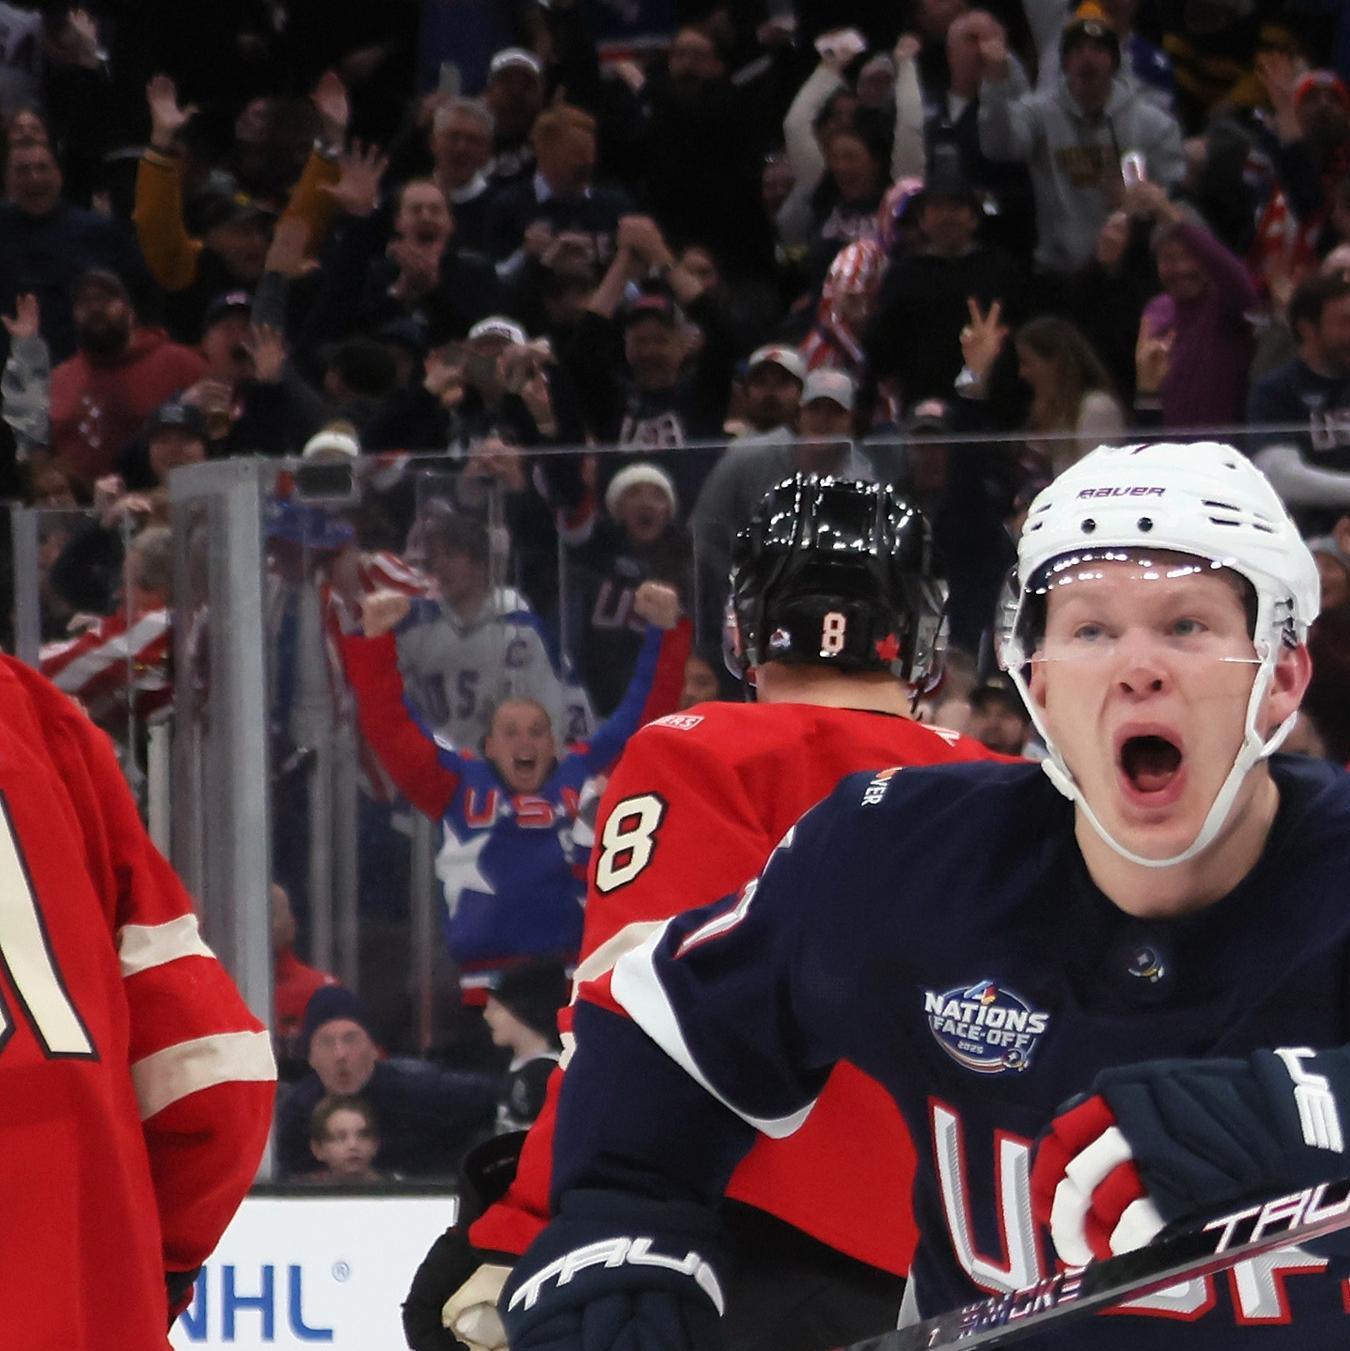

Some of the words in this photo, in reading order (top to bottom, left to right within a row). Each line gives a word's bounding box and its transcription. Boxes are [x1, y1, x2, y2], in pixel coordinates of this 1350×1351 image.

[823, 611, 847, 654] 8
[594, 792, 667, 896] 8
[924, 991, 1050, 1034] NATIONS
[933, 1015, 1031, 1048] FACE-OFF
[508, 1235, 726, 1317] TRU
